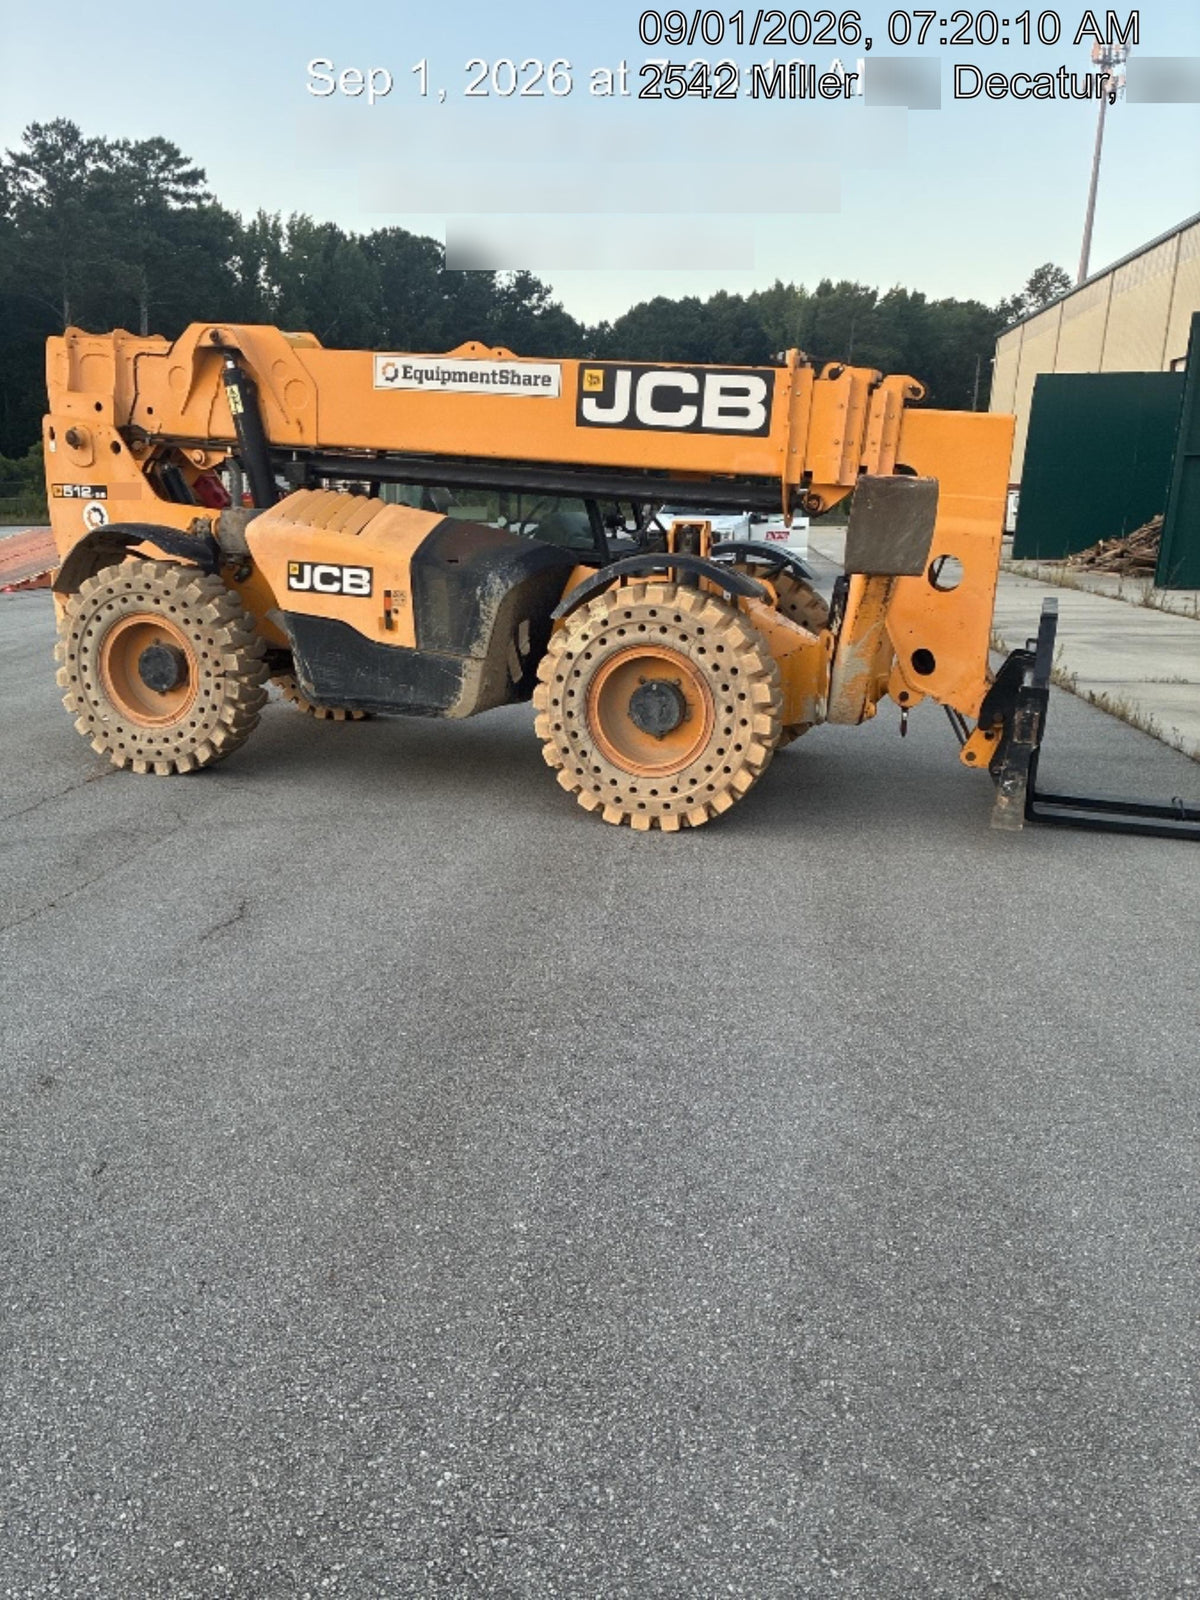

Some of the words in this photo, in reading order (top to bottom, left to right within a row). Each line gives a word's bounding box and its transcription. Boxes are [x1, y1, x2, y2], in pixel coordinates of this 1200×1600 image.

[400, 363, 553, 388] EquipmentShare
[581, 368, 768, 431] JCB
[289, 564, 371, 595] JCB
